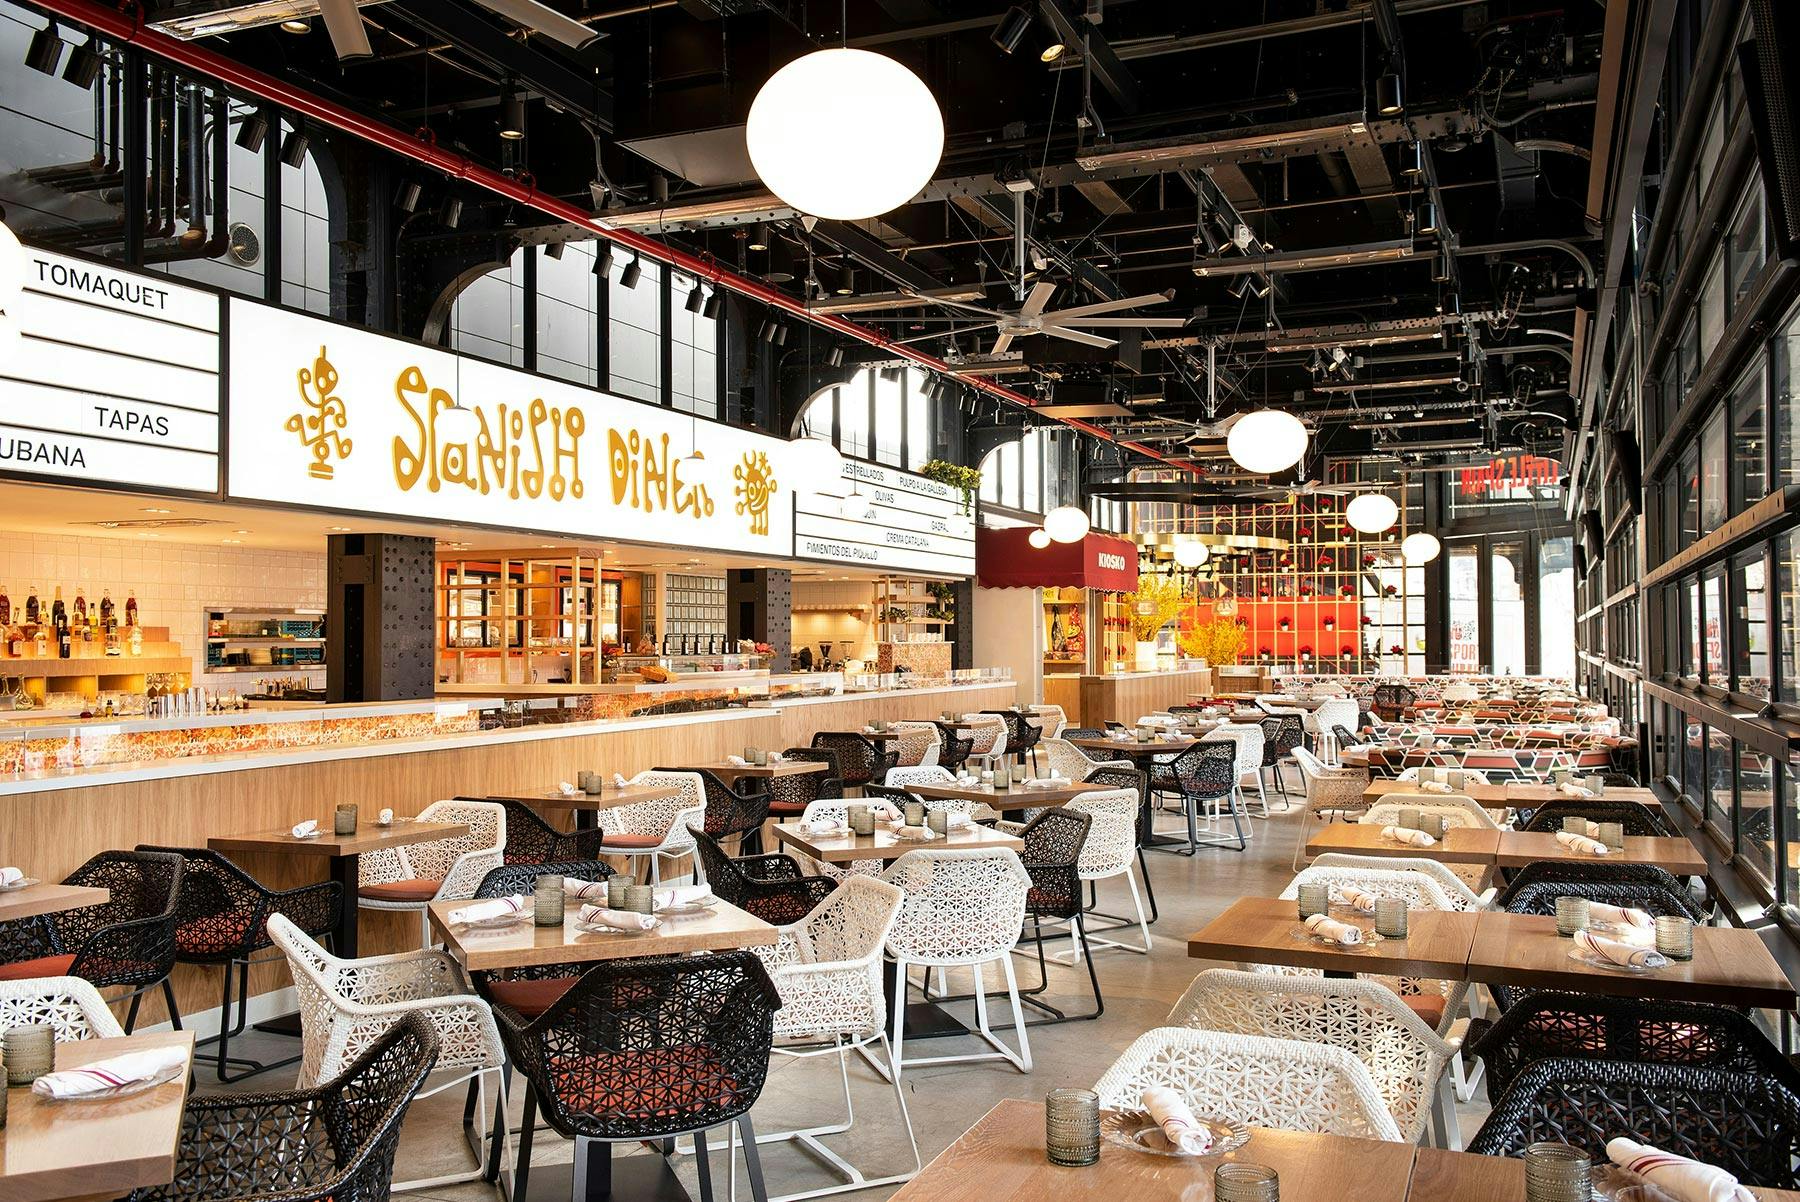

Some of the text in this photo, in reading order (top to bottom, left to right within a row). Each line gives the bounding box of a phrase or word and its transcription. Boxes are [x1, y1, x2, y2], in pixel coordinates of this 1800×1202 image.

[33, 259, 169, 310] TOMAQUET
[94, 406, 169, 437] TAPAS
[845, 463, 885, 481] ESTRELLADOS
[899, 476, 916, 489] PULPO
[874, 490, 894, 504] OLIVAS
[886, 532, 904, 544] CREMA
[840, 545, 852, 558] DEL
[1098, 552, 1125, 571] KIOSKO
